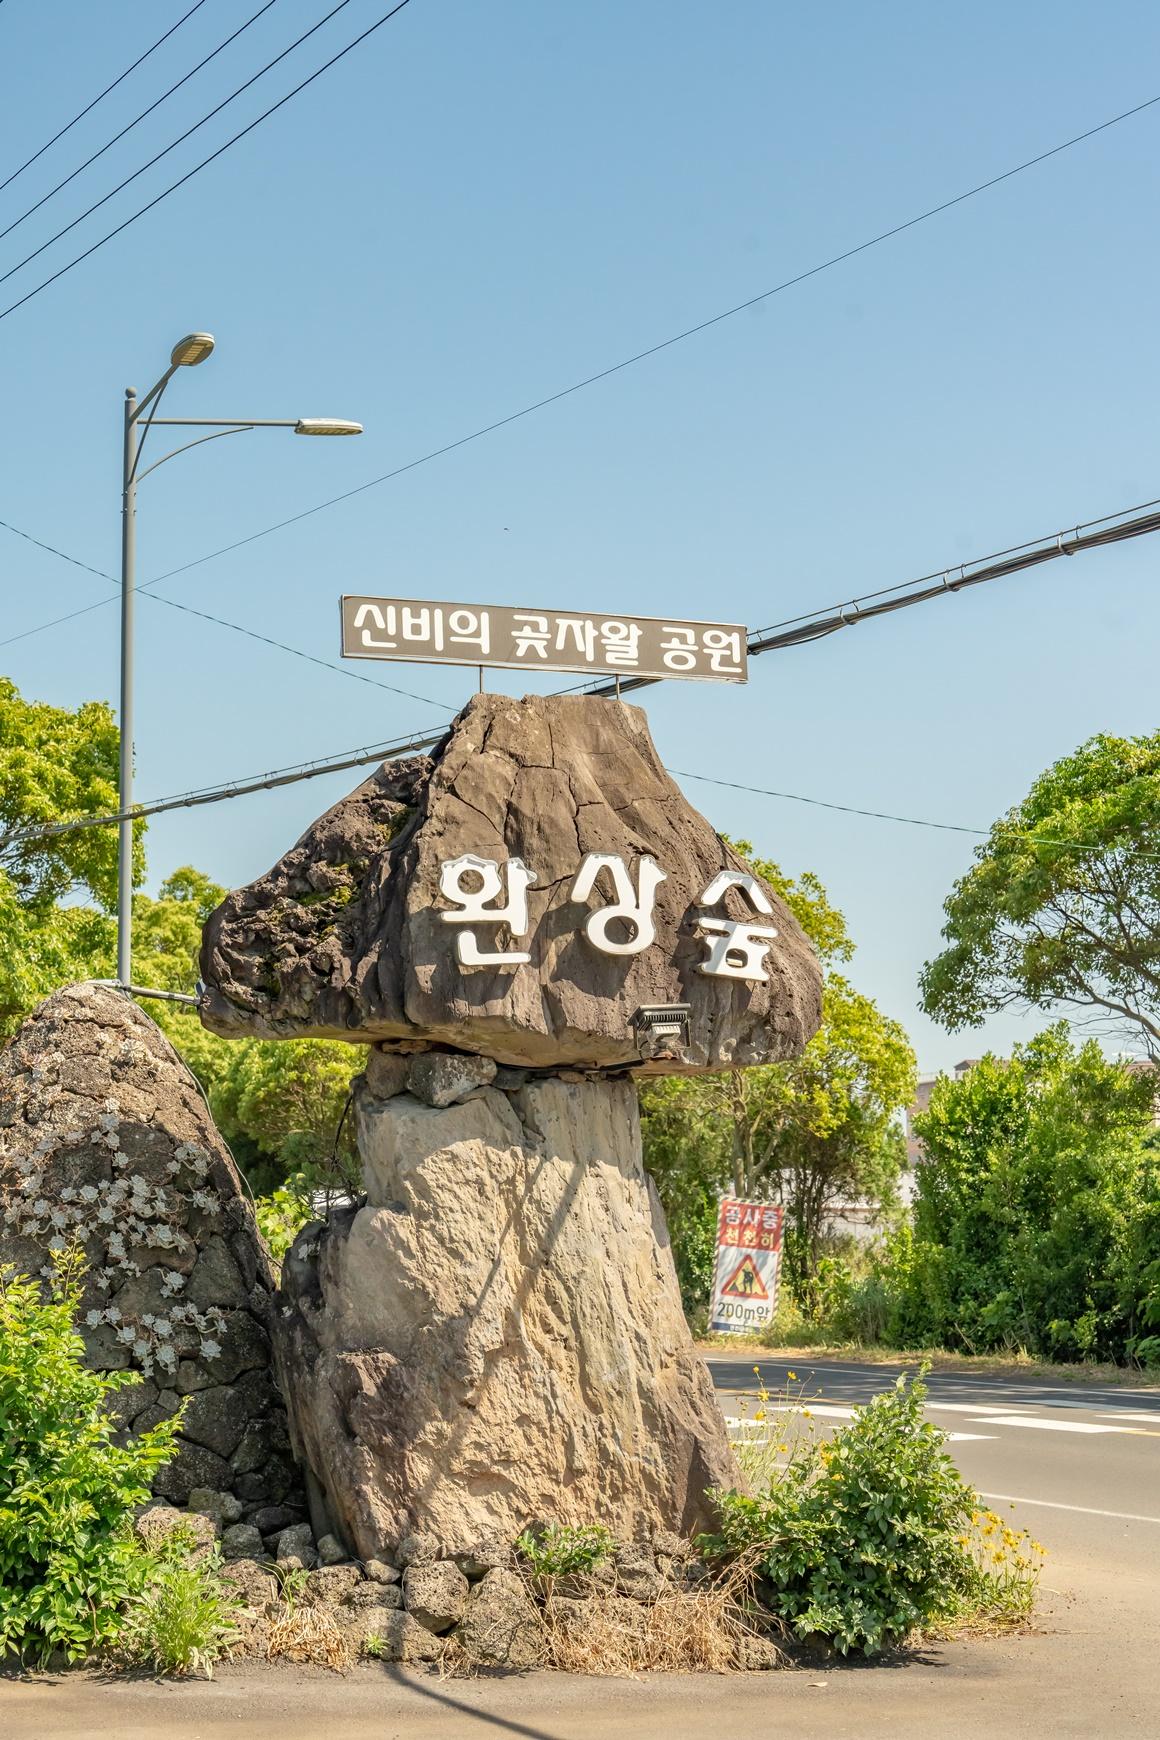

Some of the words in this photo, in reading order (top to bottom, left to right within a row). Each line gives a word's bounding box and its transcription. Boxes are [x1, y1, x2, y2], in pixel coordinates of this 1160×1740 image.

[353, 604, 490, 655] 신비의
[511, 614, 643, 666] 곶자왈
[660, 626, 743, 673] 공원
[439, 853, 779, 982] 환상숲
[725, 1205, 779, 1229] 공사중
[726, 1227, 774, 1249] 천천히
